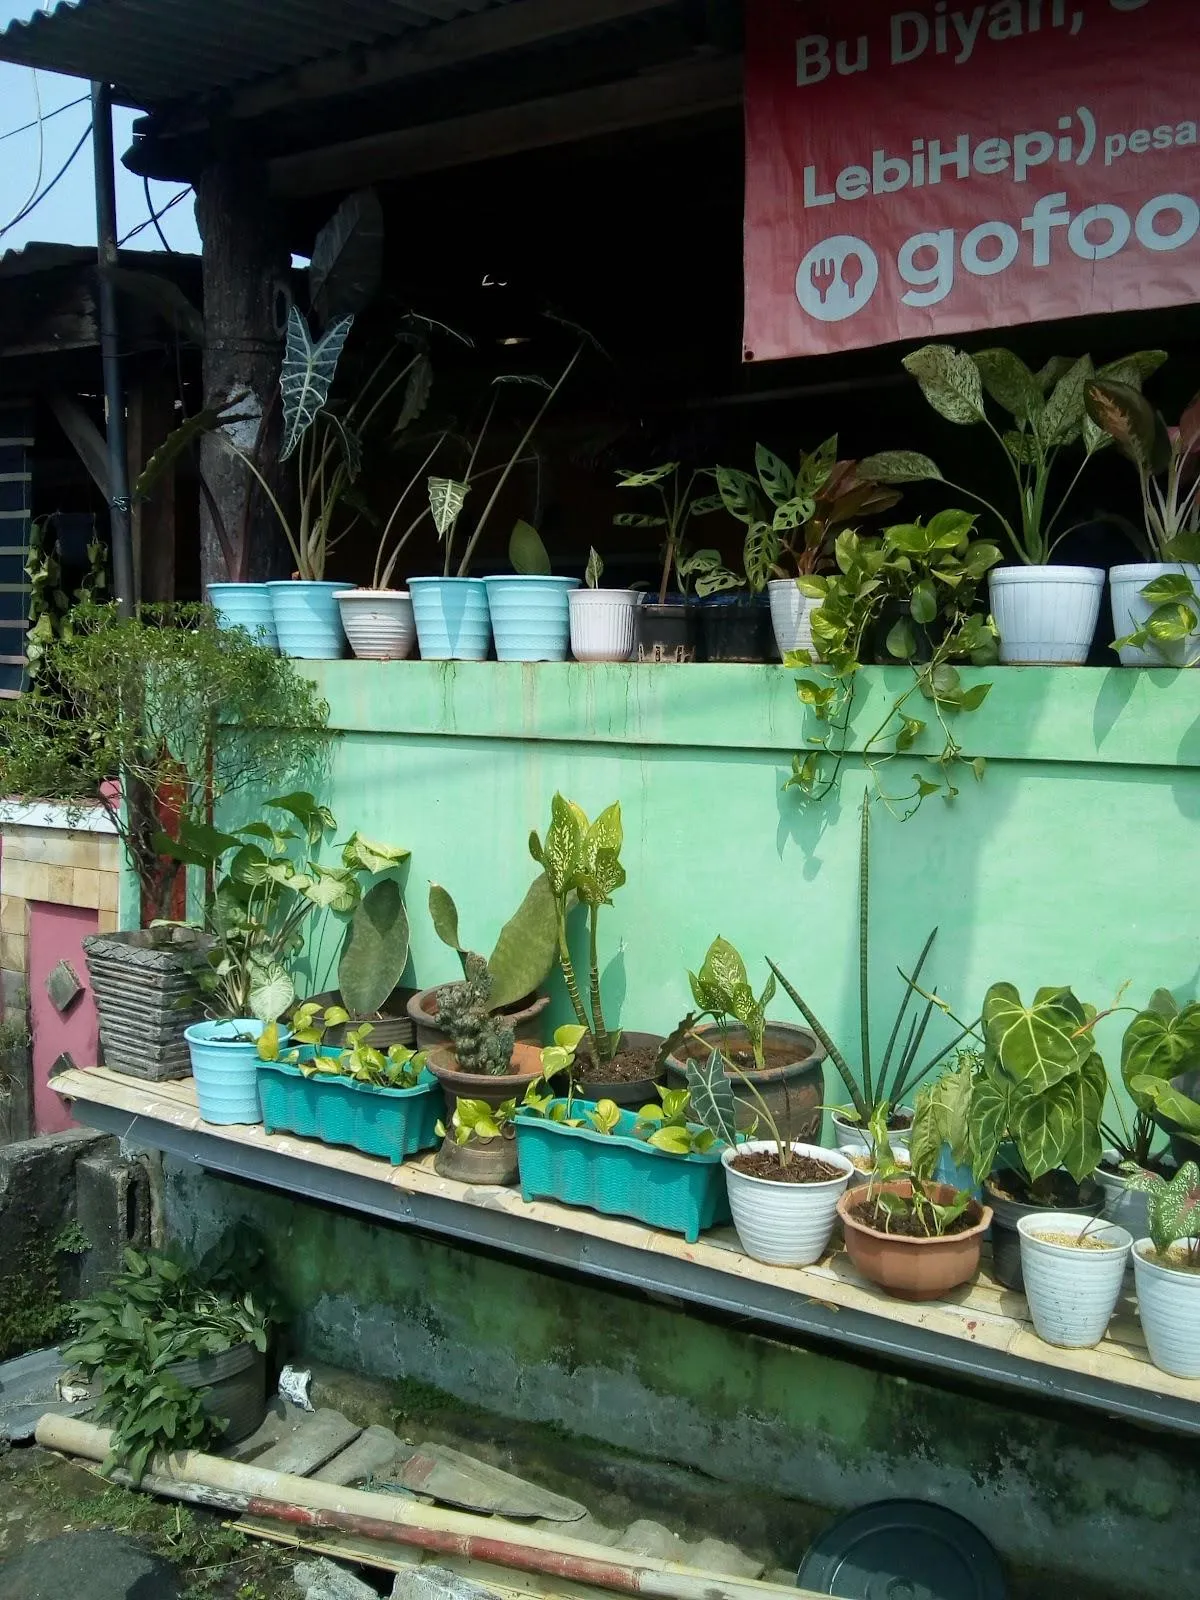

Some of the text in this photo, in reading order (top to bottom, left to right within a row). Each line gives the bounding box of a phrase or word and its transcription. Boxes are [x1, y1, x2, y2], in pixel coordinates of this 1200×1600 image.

[795, 34, 868, 87] Bu
[1104, 121, 1197, 166] pesa
[897, 191, 1200, 308] gofoo
